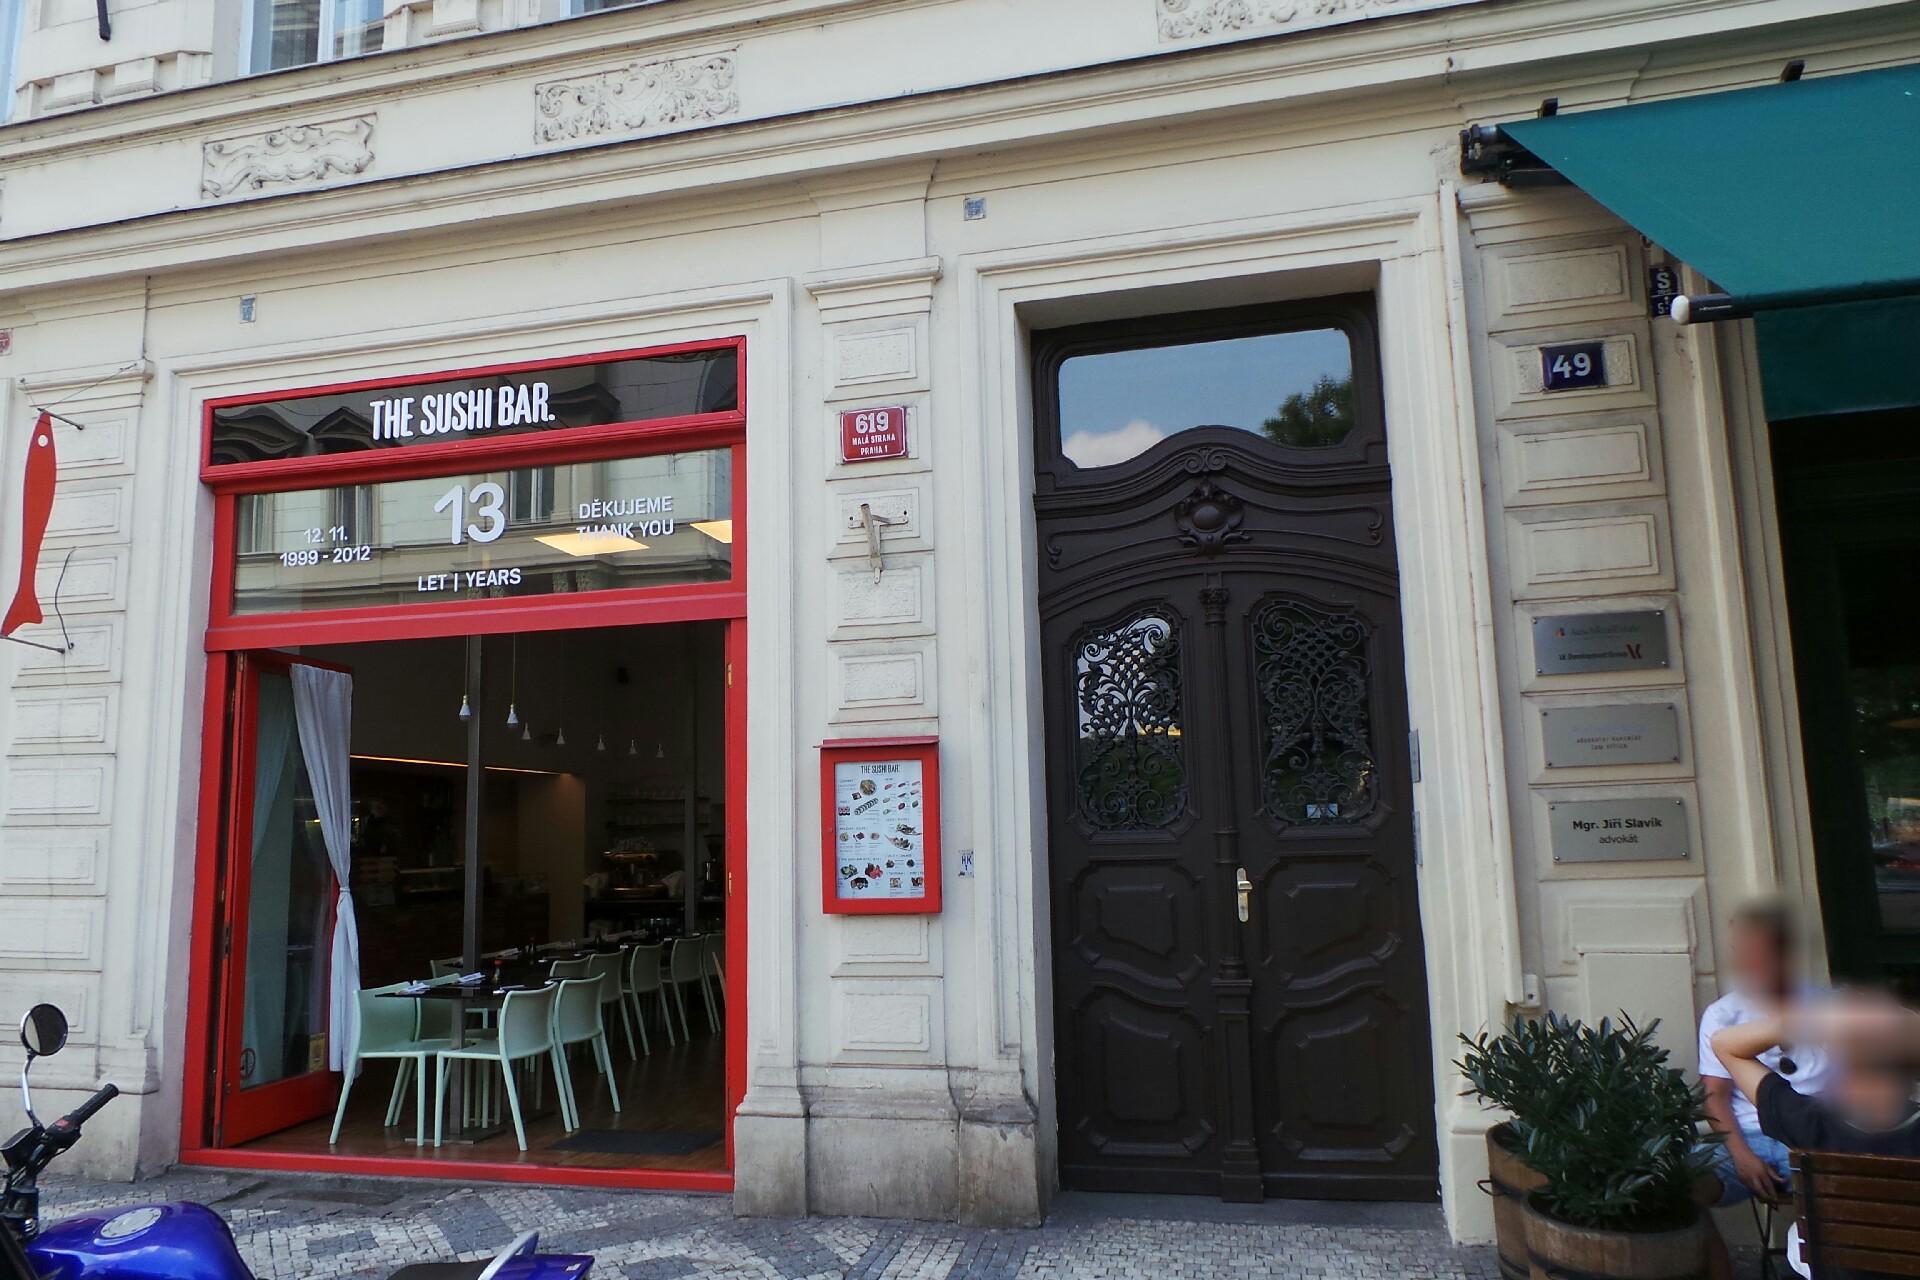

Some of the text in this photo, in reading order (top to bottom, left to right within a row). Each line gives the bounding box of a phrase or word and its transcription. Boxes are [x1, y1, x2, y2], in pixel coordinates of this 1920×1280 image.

[1552, 352, 1591, 379] 49
[369, 382, 556, 441] THE SUSHI BAR.
[855, 411, 889, 434] 619
[870, 433, 896, 443] STRANA
[860, 446, 883, 455] PRAHA
[433, 482, 505, 545] 13
[579, 496, 673, 519] DĚKUJEME
[304, 525, 348, 544] 12. 11.
[639, 518, 674, 538] YOU
[279, 550, 319, 567] 1999
[332, 545, 371, 564] 2012
[418, 573, 448, 592] LET
[465, 568, 522, 588] YEARS
[1572, 820, 1600, 832] Mgr.
